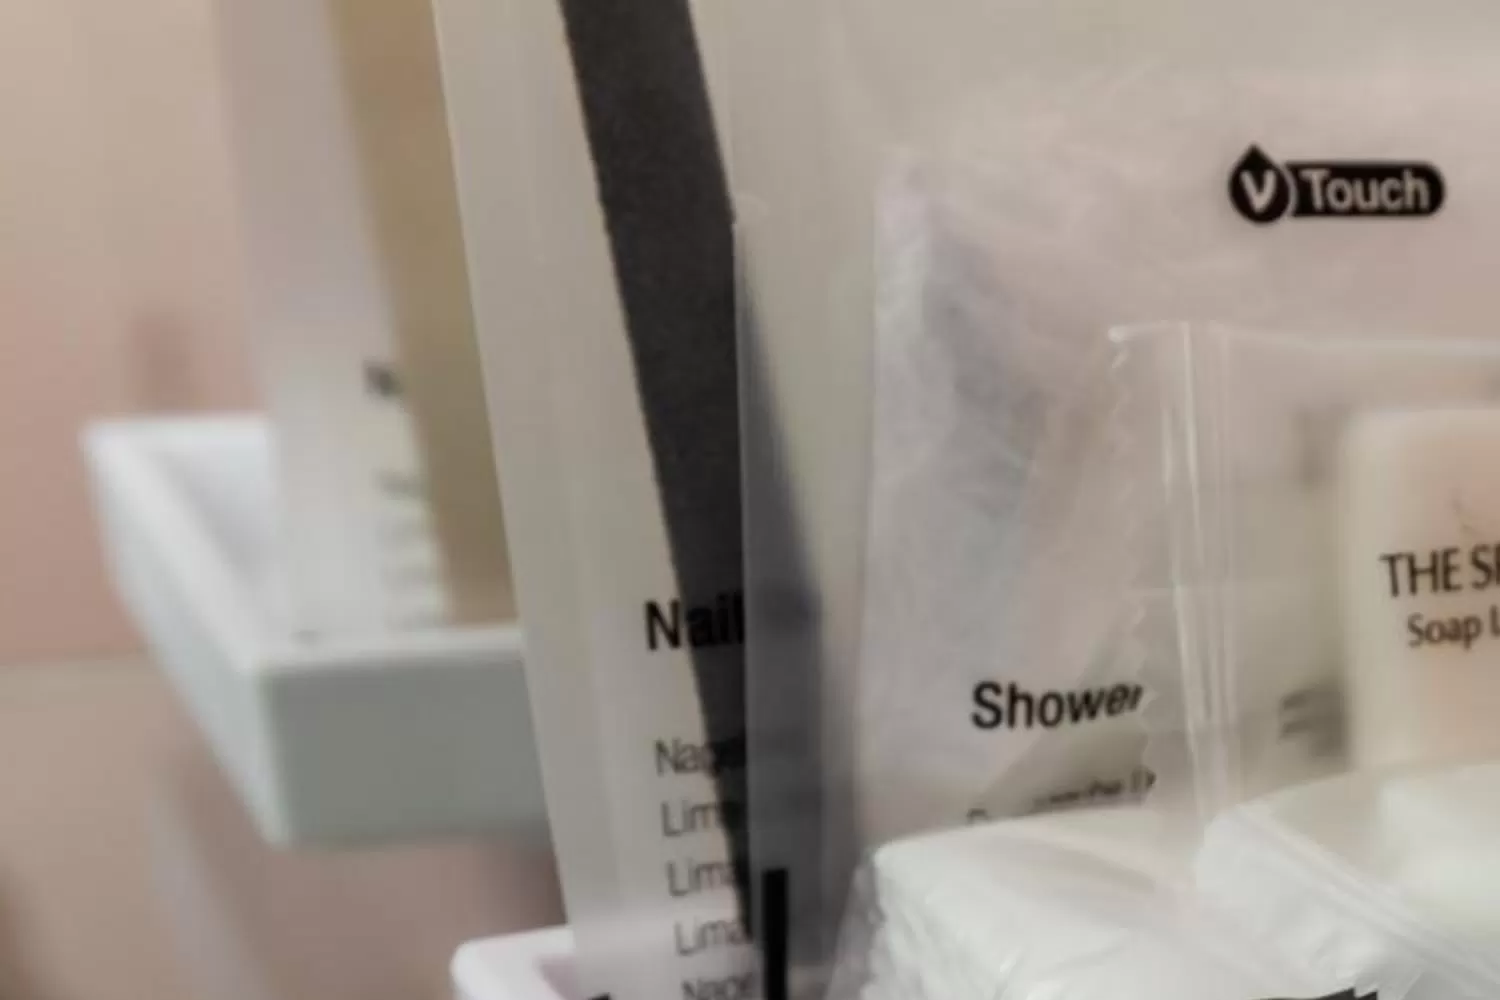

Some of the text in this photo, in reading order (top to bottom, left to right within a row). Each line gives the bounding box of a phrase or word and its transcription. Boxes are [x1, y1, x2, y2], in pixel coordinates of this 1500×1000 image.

[1299, 167, 1430, 212] Touch
[1379, 546, 1463, 598] THE
[1406, 610, 1483, 650] Soap
[970, 679, 1144, 731] Shower
